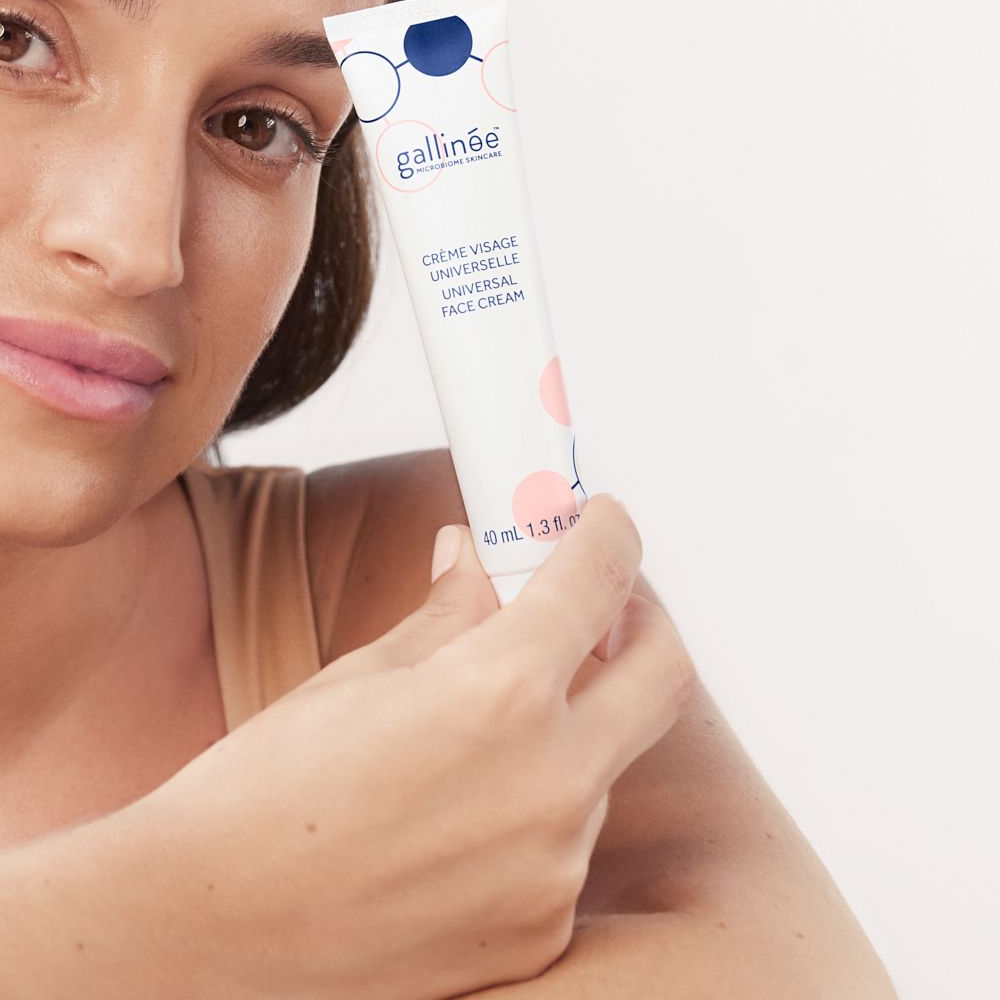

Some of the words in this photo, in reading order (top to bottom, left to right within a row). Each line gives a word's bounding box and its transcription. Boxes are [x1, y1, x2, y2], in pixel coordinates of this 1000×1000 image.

[416, 159, 464, 174] MICROBIOME
[465, 151, 502, 164] SKINCARE
[422, 246, 468, 267] CRÈME
[469, 236, 519, 255] VISAGE
[430, 253, 520, 282] UNIVERSELLE
[442, 275, 518, 300] UNIVERSAL
[441, 300, 475, 318] FACE
[478, 290, 525, 310] CREAM
[483, 530, 497, 546] 40
[501, 525, 523, 543] mL
[526, 519, 550, 538] 1.3
[553, 515, 567, 532] fl.
